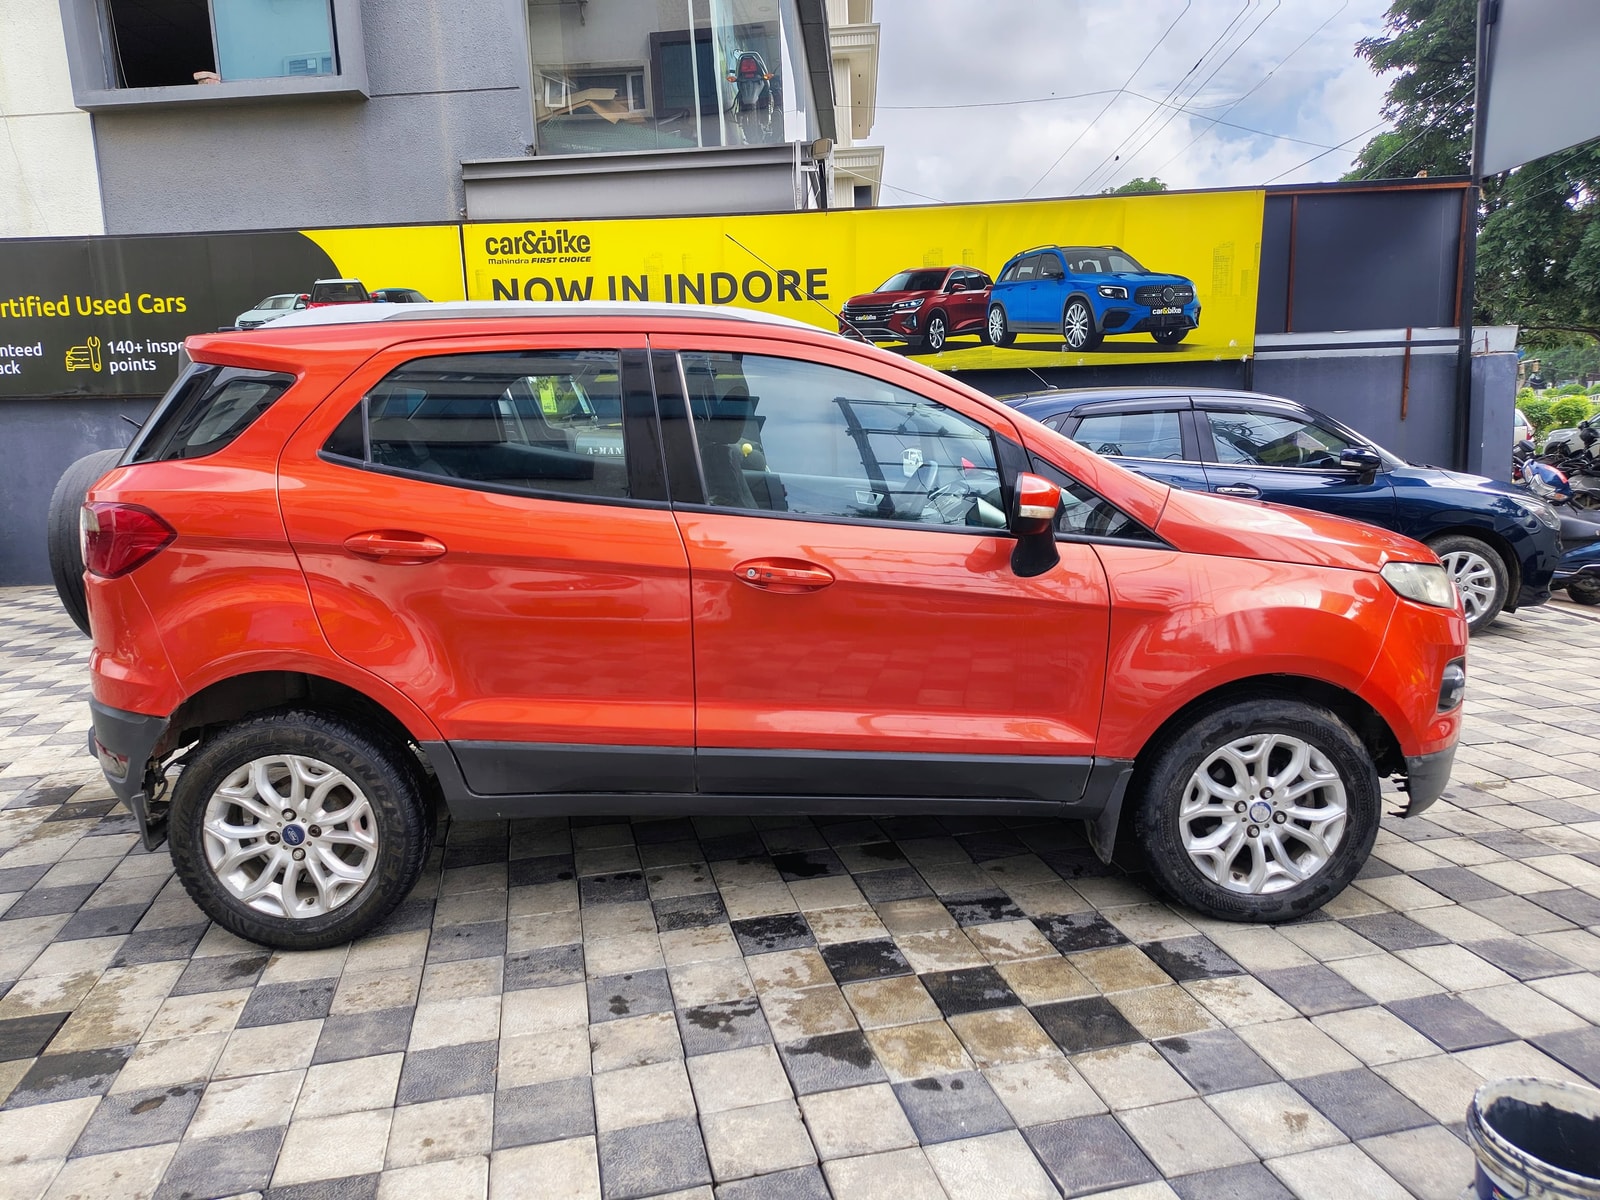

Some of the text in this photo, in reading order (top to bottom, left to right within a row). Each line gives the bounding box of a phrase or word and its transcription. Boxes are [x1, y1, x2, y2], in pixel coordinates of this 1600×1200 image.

[485, 229, 591, 255] car&bike
[492, 268, 829, 304] NOW IN INDORE
[75, 293, 131, 316] Used
[137, 293, 187, 313] Cars
[107, 341, 143, 354] 140+
[109, 358, 157, 375] points
[586, 446, 622, 455] A-MAN
